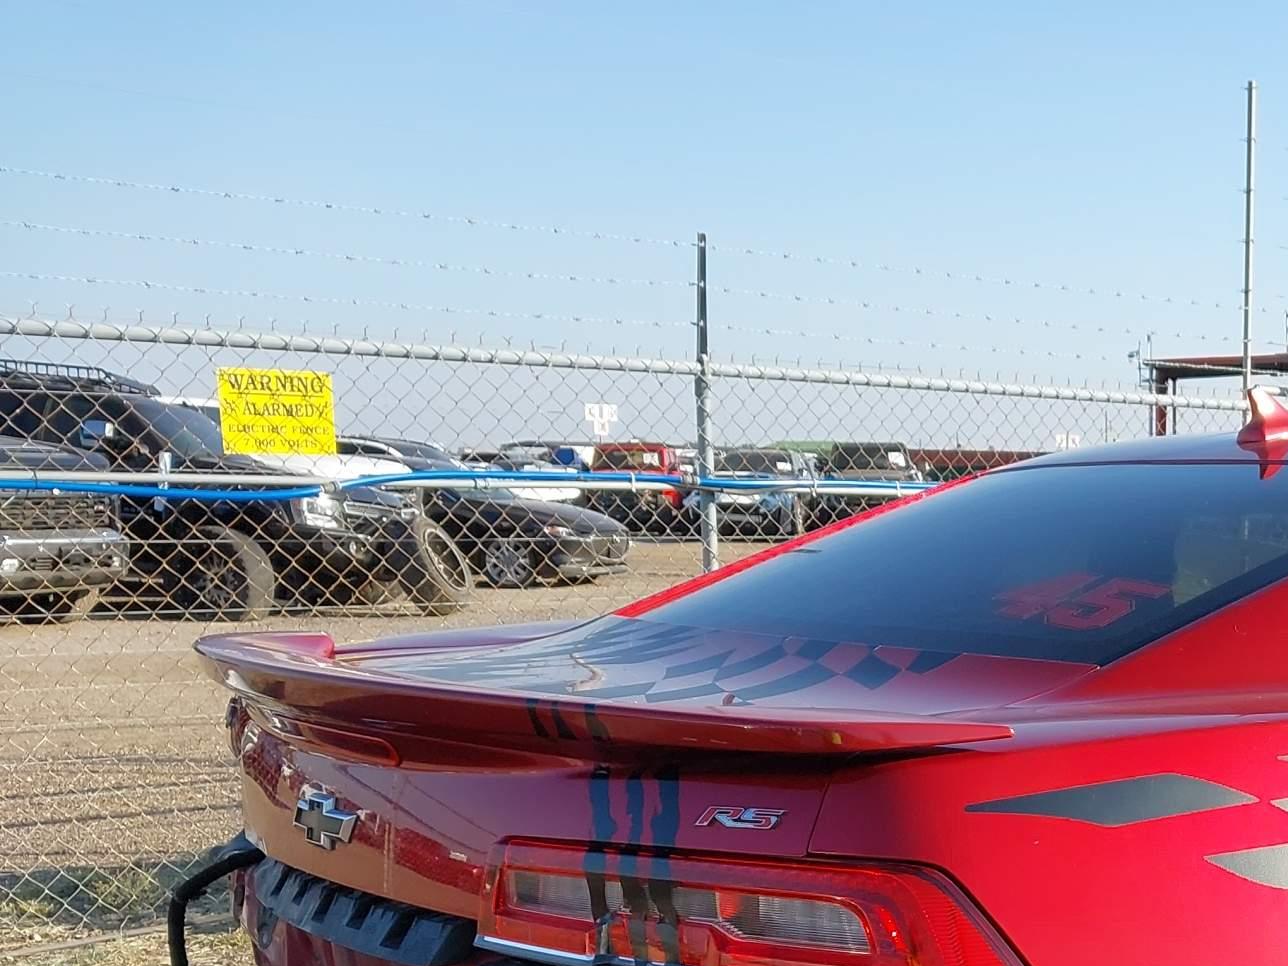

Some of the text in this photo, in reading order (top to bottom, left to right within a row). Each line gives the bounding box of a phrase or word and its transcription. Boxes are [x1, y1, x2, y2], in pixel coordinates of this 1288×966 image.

[227, 373, 324, 393] WARNING
[242, 400, 315, 418] ALARMED
[228, 423, 330, 436] ELECTRIC FENCE
[280, 439, 318, 449] VOLTS
[694, 805, 787, 830] RS
